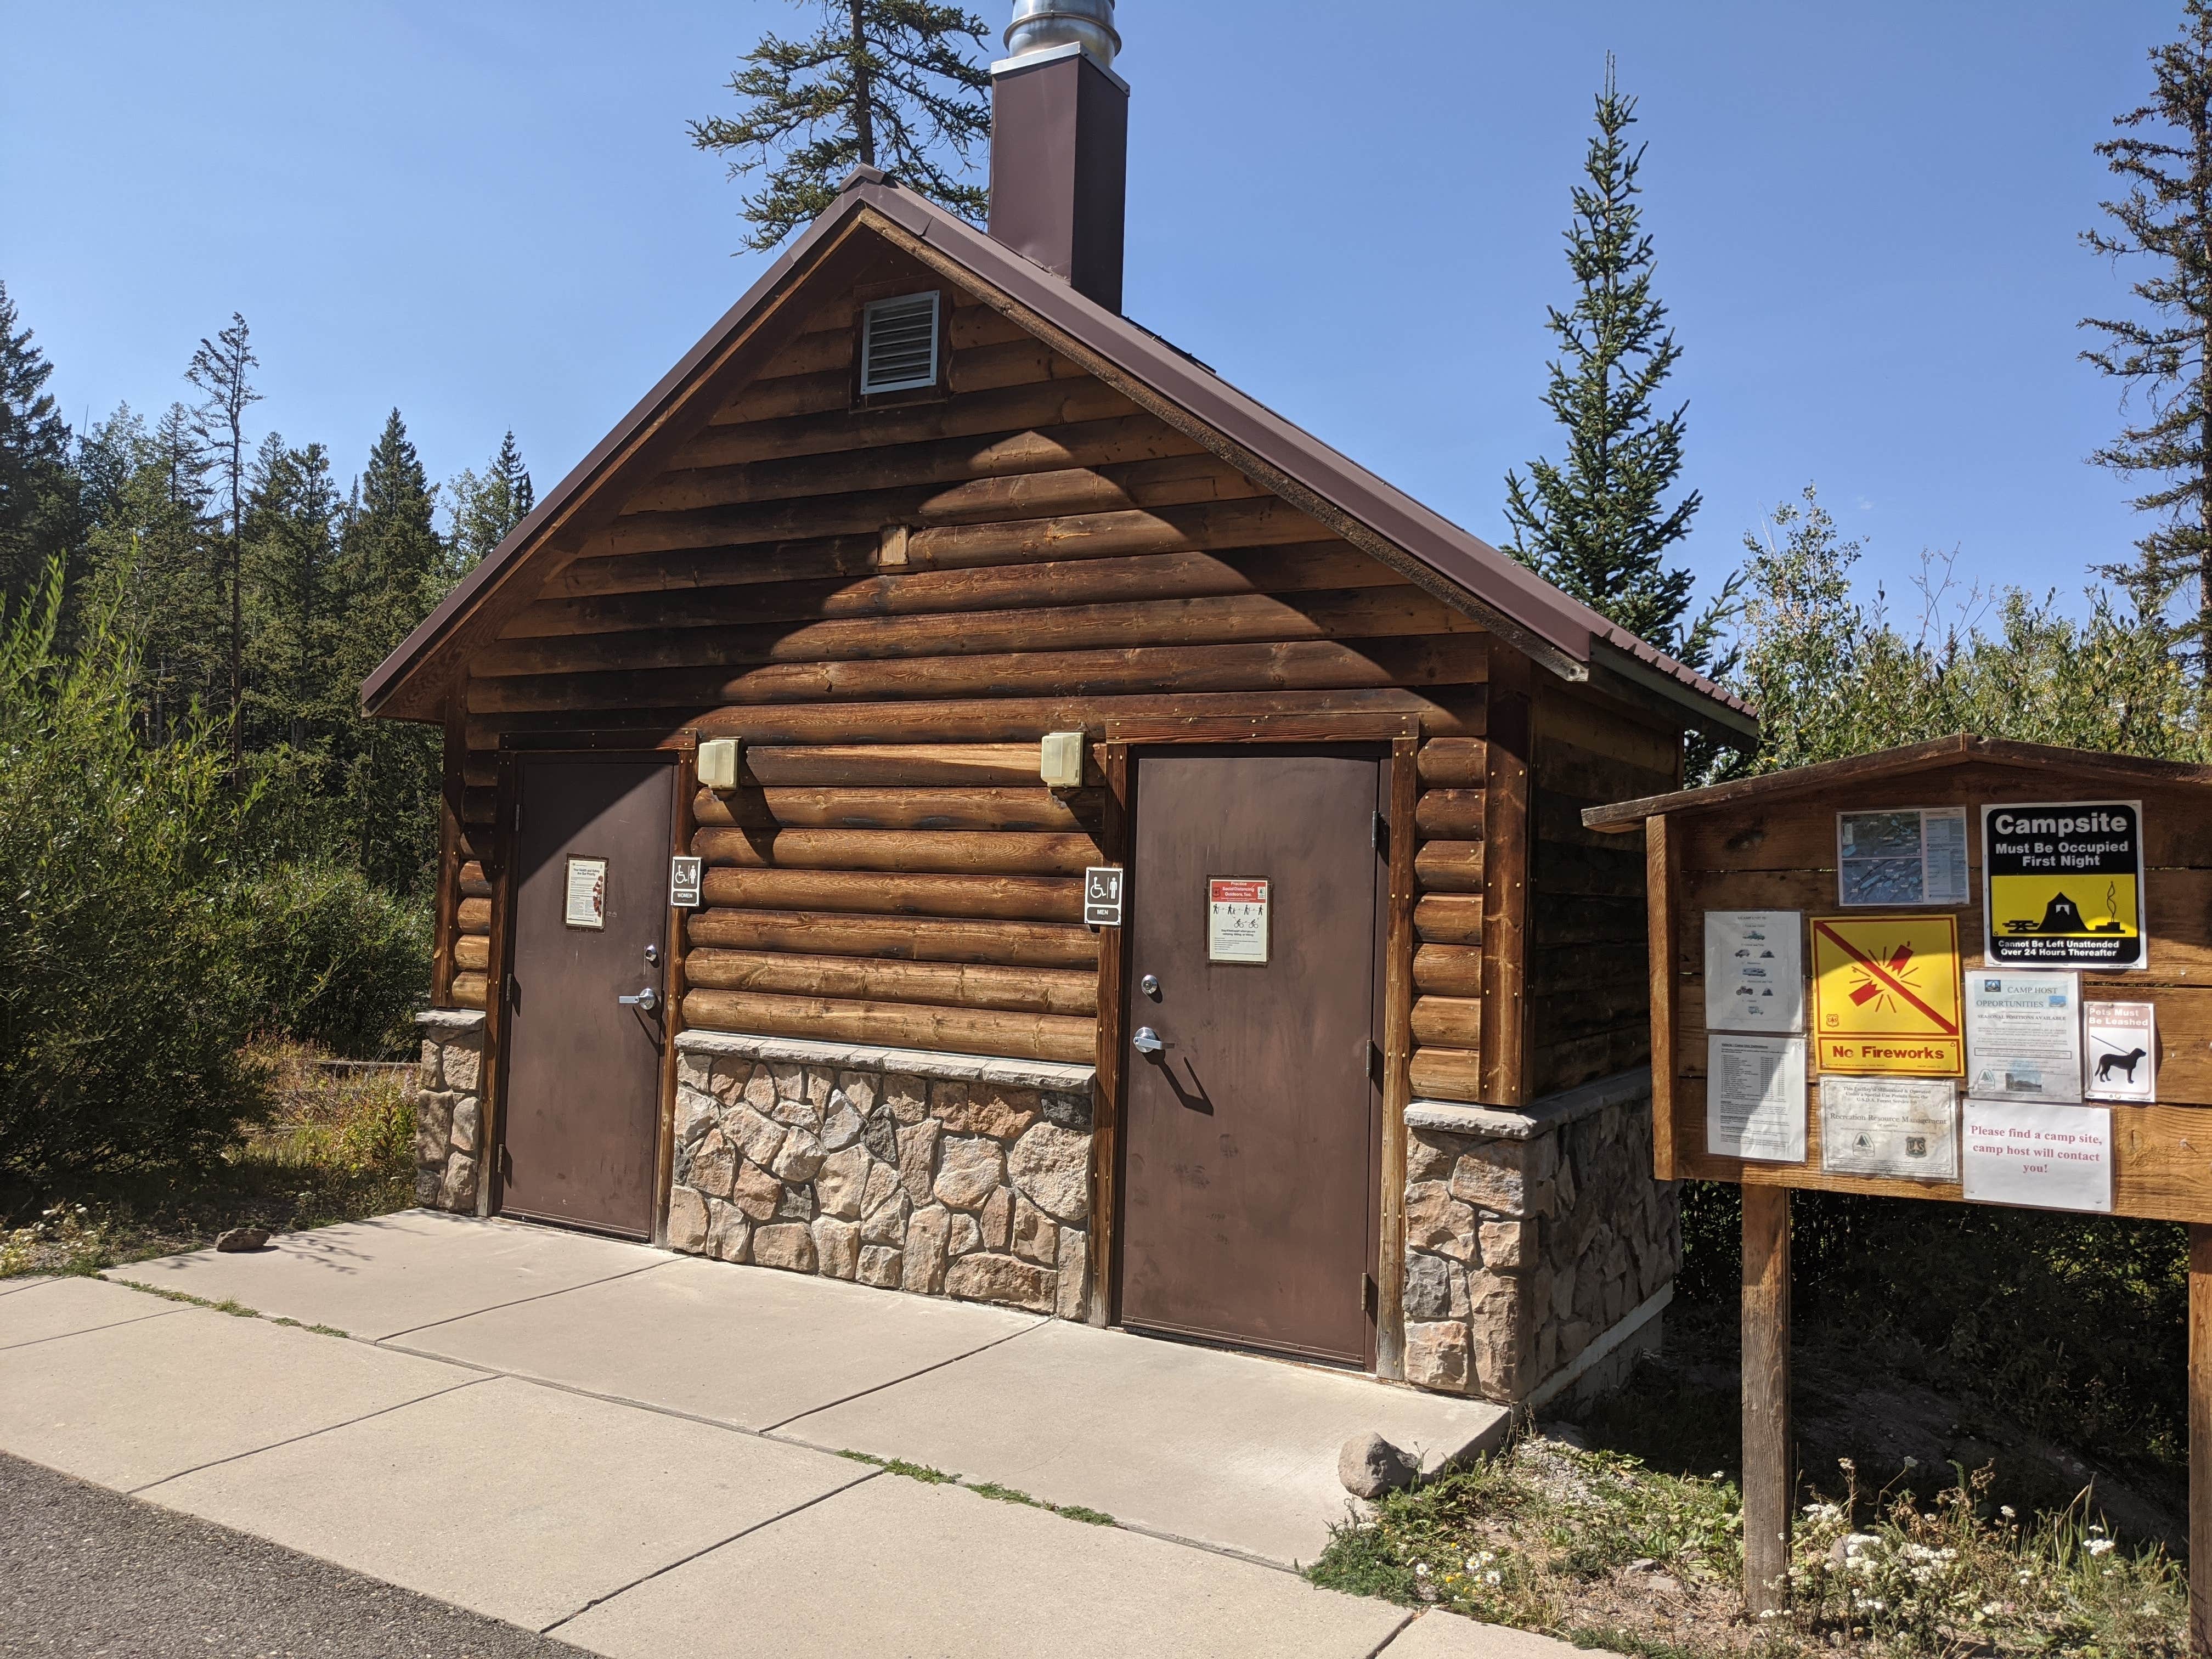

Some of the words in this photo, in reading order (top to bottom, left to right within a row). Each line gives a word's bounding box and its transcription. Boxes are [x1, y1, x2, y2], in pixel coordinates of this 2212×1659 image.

[1995, 812, 2127, 837] Campsite
[1996, 843, 2029, 854] Must
[2034, 842, 2053, 853] Be
[2058, 840, 2129, 854] Occupied
[2023, 855, 2056, 867] First
[2061, 855, 2101, 868] Night
[2066, 940, 2119, 949] Unattended
[1976, 1000, 2044, 1008] OPPORTUNITIES
[2114, 1008, 2139, 1017] Must
[2106, 1018, 2148, 1026] Leashed
[1861, 1046, 1944, 1059] Fireworks
[1869, 1114, 1900, 1122] Resource
[1901, 1116, 1948, 1125] Management
[1971, 1125, 2005, 1136] Please
[2008, 1128, 2031, 1138] find
[2044, 1133, 2076, 1144] camp
[2079, 1133, 2102, 1145] site,
[1973, 1145, 2003, 1155] camp
[2007, 1146, 2030, 1156] host
[2033, 1148, 2054, 1158] will
[2057, 1151, 2100, 1161] contact
[2023, 1164, 2049, 1173] you!
